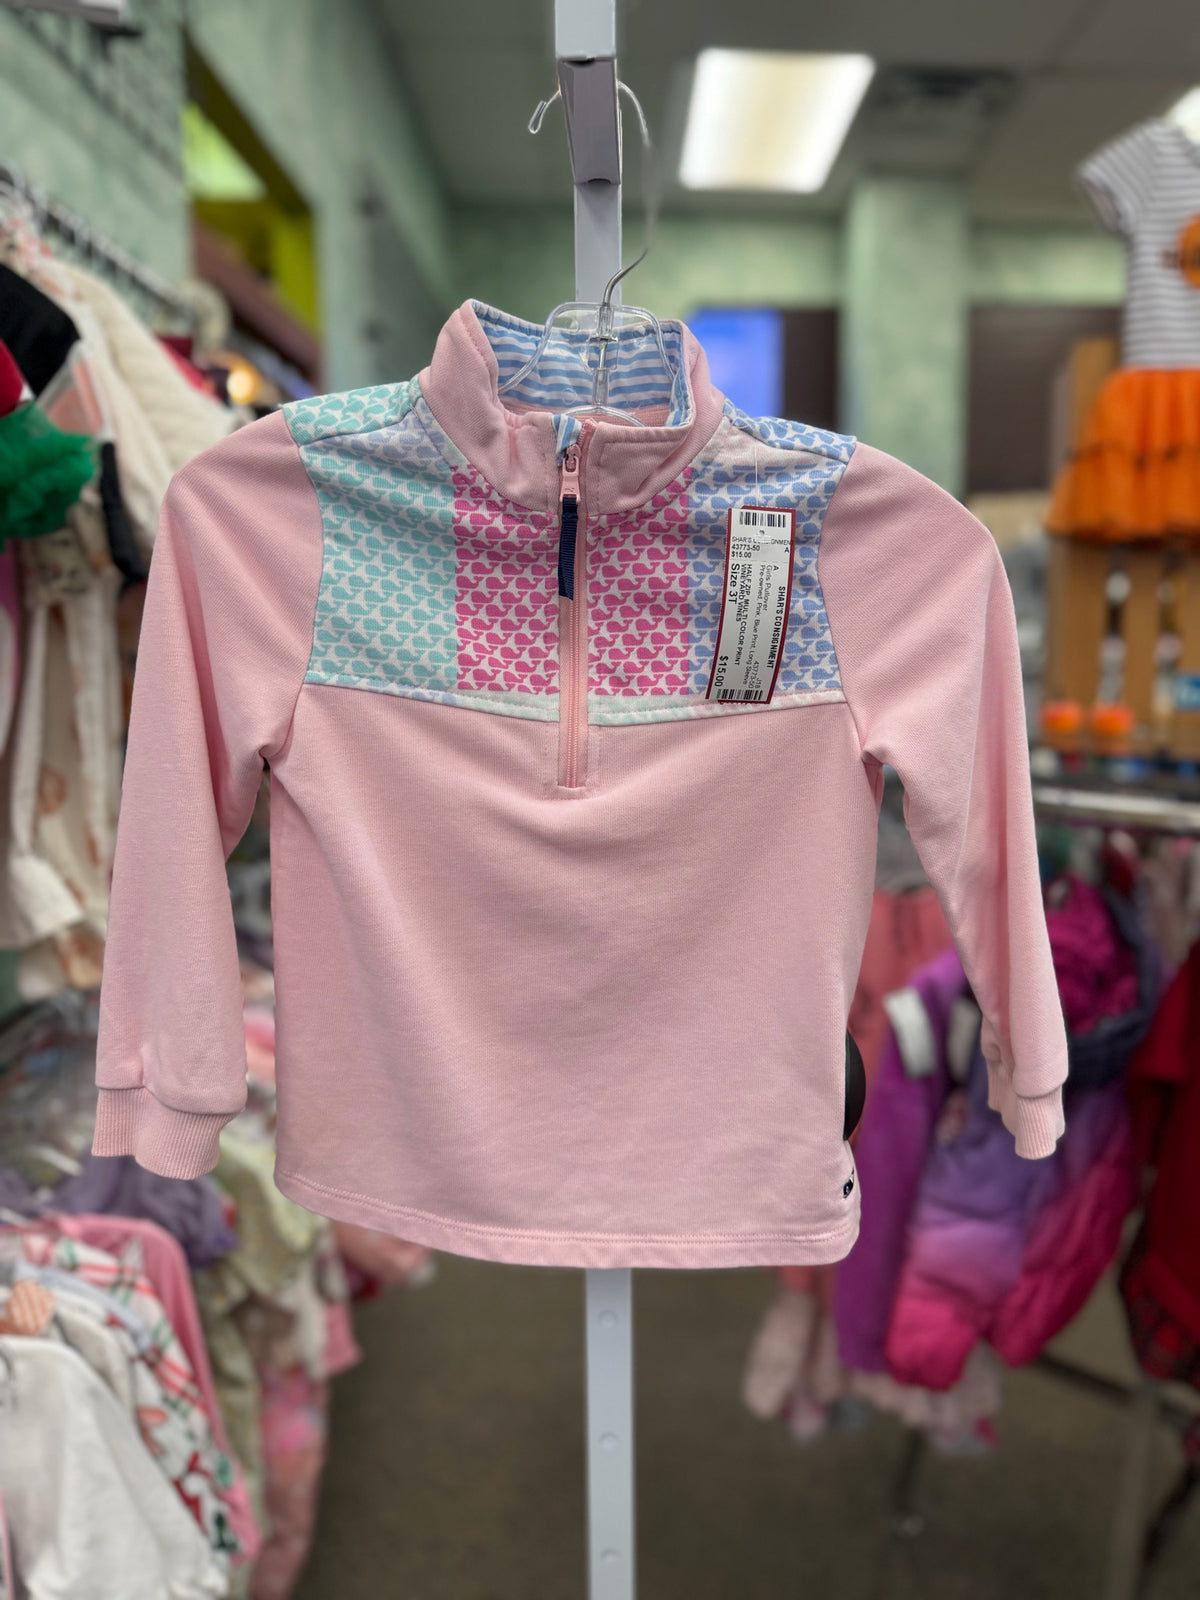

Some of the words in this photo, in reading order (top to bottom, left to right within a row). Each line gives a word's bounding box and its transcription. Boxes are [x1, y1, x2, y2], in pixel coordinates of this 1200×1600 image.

[730, 563, 740, 587] Size
[729, 591, 738, 604] 3T
[763, 583, 771, 611] Pullover
[776, 586, 785, 614] SHAR'S
[738, 621, 747, 645] COLOR
[767, 616, 782, 669] CONSIGNMENT
[734, 647, 743, 665] PRINT
[746, 651, 755, 665] Long
[715, 656, 728, 687] $15.00
[743, 666, 751, 684] Sleeve
[749, 661, 759, 688] 43773-50
